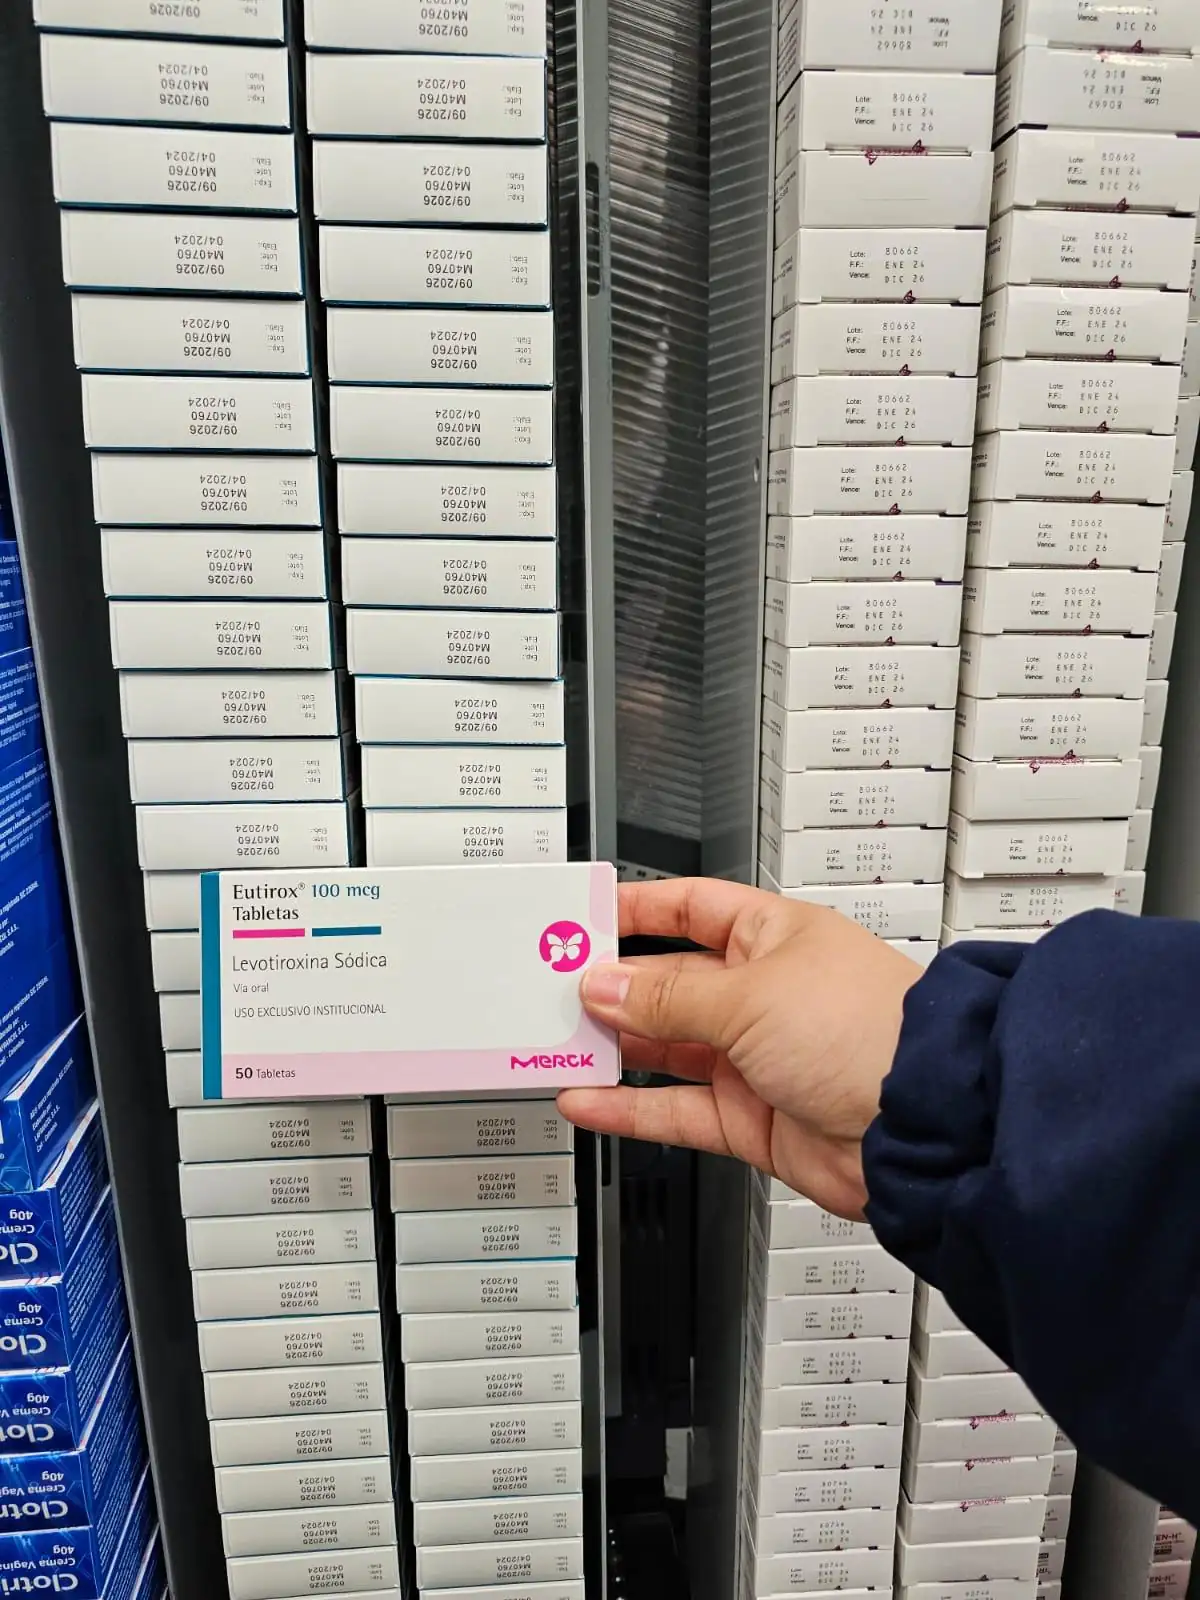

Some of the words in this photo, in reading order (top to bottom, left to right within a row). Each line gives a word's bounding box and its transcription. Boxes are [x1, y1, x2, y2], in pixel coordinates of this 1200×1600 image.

[149, 4, 200, 17] 09/2026
[420, 8, 468, 22] M40760
[418, 23, 469, 37] 09/2026
[158, 64, 208, 76] 04/2024
[161, 78, 209, 91] M40760
[417, 78, 466, 90] 04/2024
[159, 93, 209, 107] 09/2026
[419, 93, 466, 105] M40760
[417, 108, 466, 121] 09/2026
[166, 151, 216, 163] 04/2024
[168, 165, 217, 178] M40760
[423, 165, 471, 177] 04/2024
[167, 179, 217, 193] 09/2026
[425, 179, 471, 192] M40760
[423, 194, 471, 207] 09/2026
[174, 234, 224, 247] 04/2024
[177, 248, 224, 261] M40760
[425, 249, 473, 261] 04/2024
[175, 263, 225, 275] 09/2026
[427, 263, 473, 275] M40760
[425, 277, 473, 289] 09/2026
[182, 318, 230, 330] 04/2024
[184, 332, 231, 344] M40760
[430, 330, 477, 342] 04/2024
[183, 346, 232, 358] 09/2026
[432, 344, 477, 356] M40760
[430, 358, 478, 370] 09/2026
[188, 397, 236, 408] 04/2024
[190, 410, 237, 422] M40760
[435, 409, 481, 420] 04/2024
[189, 424, 238, 436] 09/2026
[436, 422, 481, 433] M40760
[435, 436, 481, 447] 09/2026
[199, 474, 247, 485] 04/2024
[201, 487, 247, 499] M40760
[440, 485, 486, 497] 04/2024
[200, 500, 248, 512] 09/2026
[442, 498, 487, 510] M40760
[440, 512, 487, 523] 09/2026
[214, 621, 261, 633] 04/2024
[217, 633, 261, 644] M40760
[446, 630, 490, 640] 04/2024
[216, 646, 262, 656] 09/2026
[448, 642, 491, 653] M40760
[446, 654, 491, 665] 09/2026
[229, 757, 273, 767] 04/2024
[459, 763, 501, 773] 04/2024
[231, 769, 274, 779] M40760
[460, 775, 501, 785] M40760
[230, 780, 274, 791] 09/2026
[459, 786, 501, 796] 09/2026
[234, 823, 279, 833] 04/2024
[463, 825, 504, 836] 04/2024
[237, 835, 280, 845] M40760
[464, 837, 504, 847] M40760
[236, 846, 280, 857] 09/2026
[462, 848, 504, 858] 09/2026
[311, 883, 340, 898] 100
[345, 885, 381, 900] mcg
[231, 904, 300, 922] Tabletas
[232, 954, 329, 972] Levotiroxina
[334, 951, 387, 969] Sódica
[233, 983, 248, 993] Vía
[250, 982, 269, 993] oral
[234, 1007, 255, 1018] USO
[257, 1005, 311, 1018] EXCLUSIVO
[313, 1003, 387, 1016] INSTITUCIONAL
[235, 1066, 254, 1080] 50
[255, 1068, 296, 1079] Tabletas
[9, 1209, 33, 1221] 40g
[18, 1302, 42, 1313] 40g
[4, 1316, 43, 1326] Crema
[26, 1393, 50, 1404] 40g
[12, 1407, 51, 1416] Crema
[42, 1471, 64, 1482] 40g
[28, 1484, 66, 1494] Crema
[53, 1545, 75, 1555] 40g
[39, 1557, 76, 1567] Crema
[1, 1573, 78, 1596] Clotri
